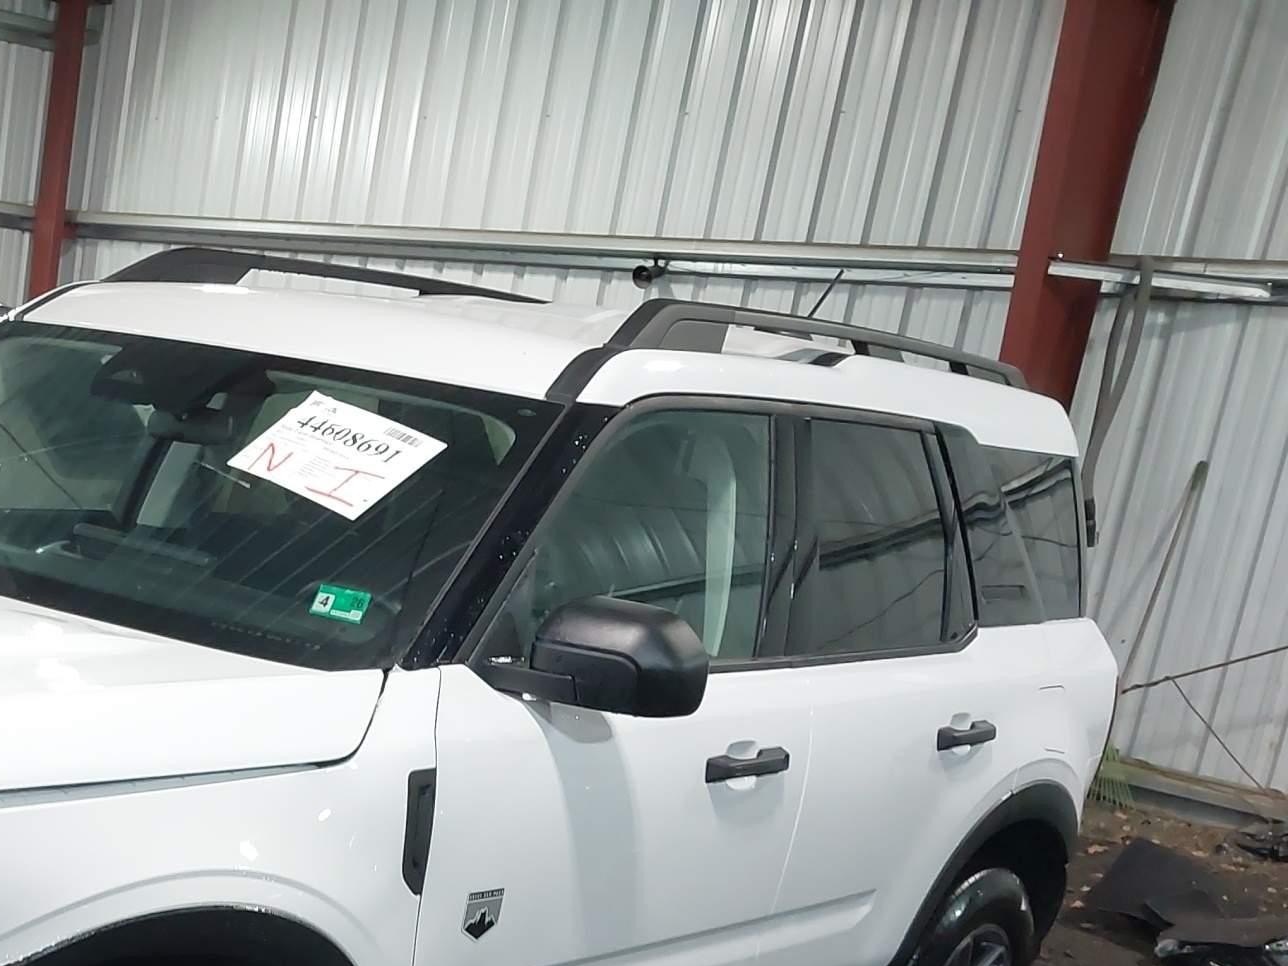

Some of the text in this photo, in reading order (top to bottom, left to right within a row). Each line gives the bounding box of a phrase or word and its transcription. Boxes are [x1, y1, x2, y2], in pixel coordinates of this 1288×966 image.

[297, 415, 403, 463] 44608691
[247, 442, 294, 472] N
[318, 595, 331, 608] 4
